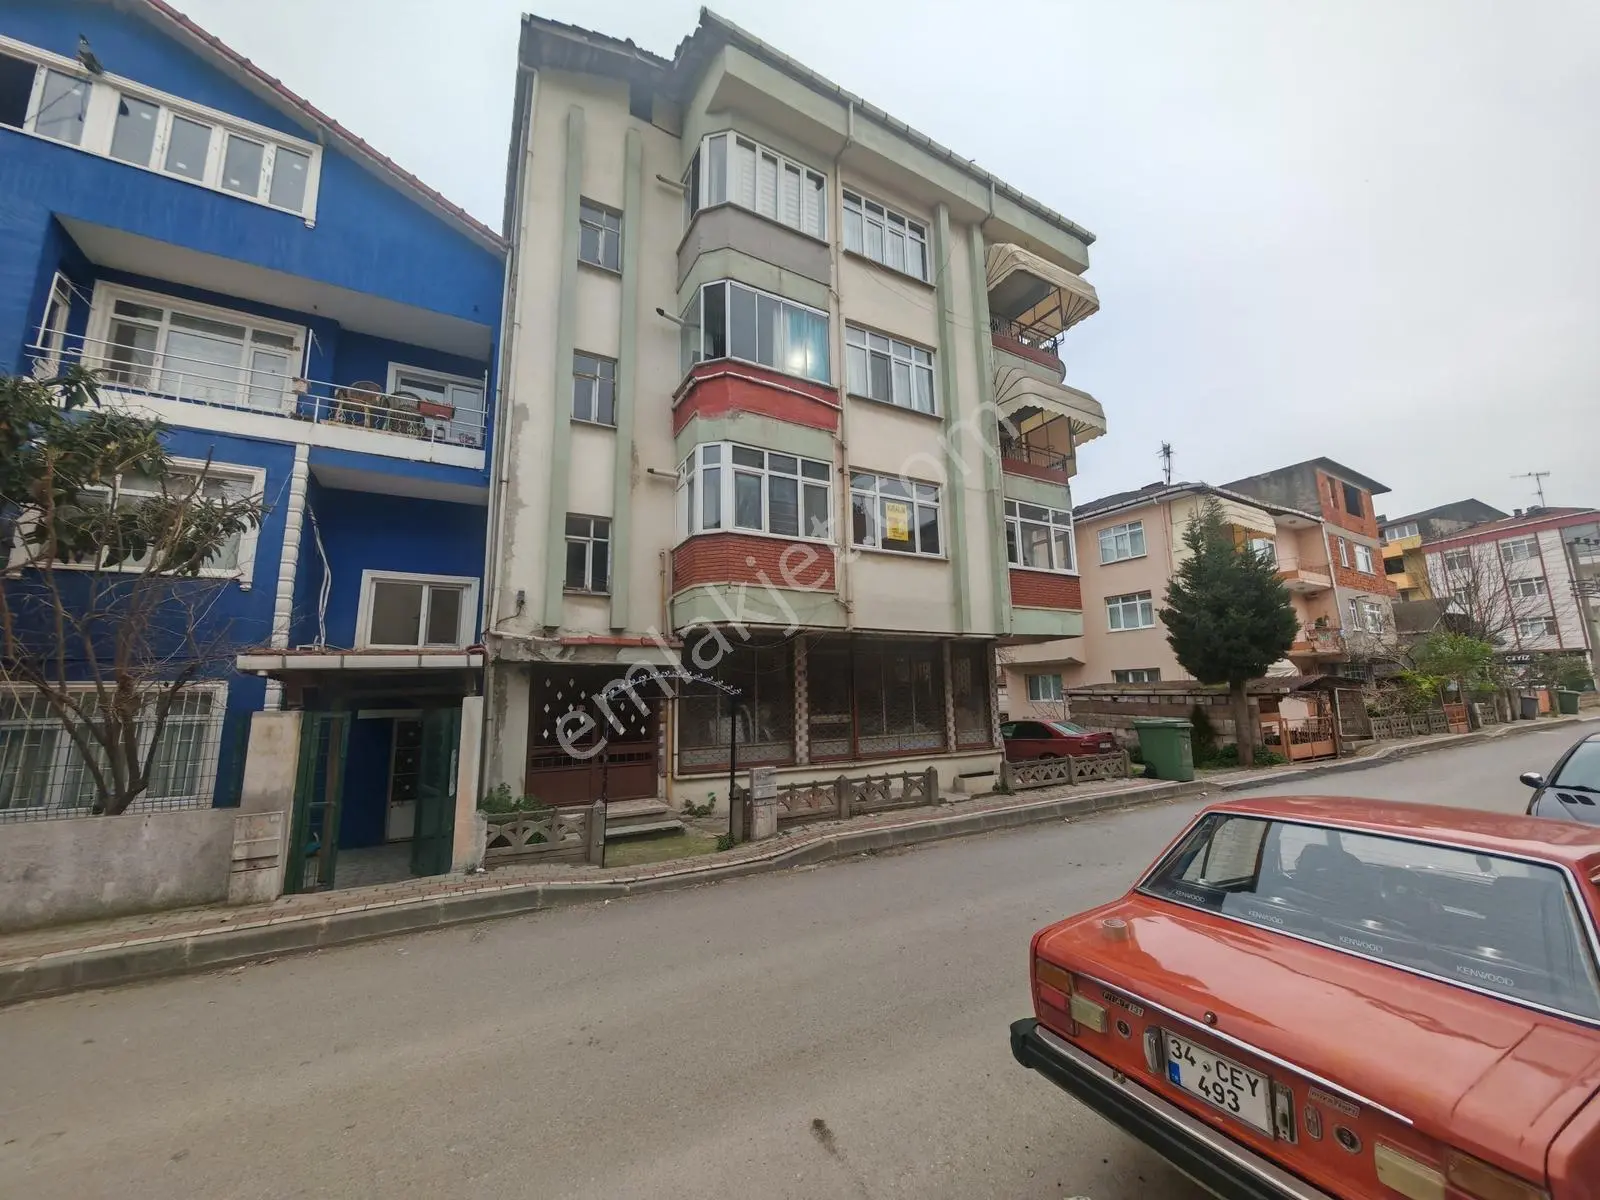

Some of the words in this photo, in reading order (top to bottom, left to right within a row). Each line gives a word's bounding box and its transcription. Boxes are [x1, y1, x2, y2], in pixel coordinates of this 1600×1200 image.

[1175, 889, 1206, 903] KENWOOD
[1248, 910, 1284, 925] KENWOOD
[1339, 935, 1384, 953] KENWOOD
[1456, 964, 1515, 988] KENWOOD
[1171, 1039, 1197, 1067] 34
[1215, 1060, 1259, 1098] CEY
[1198, 1075, 1241, 1113] 493
